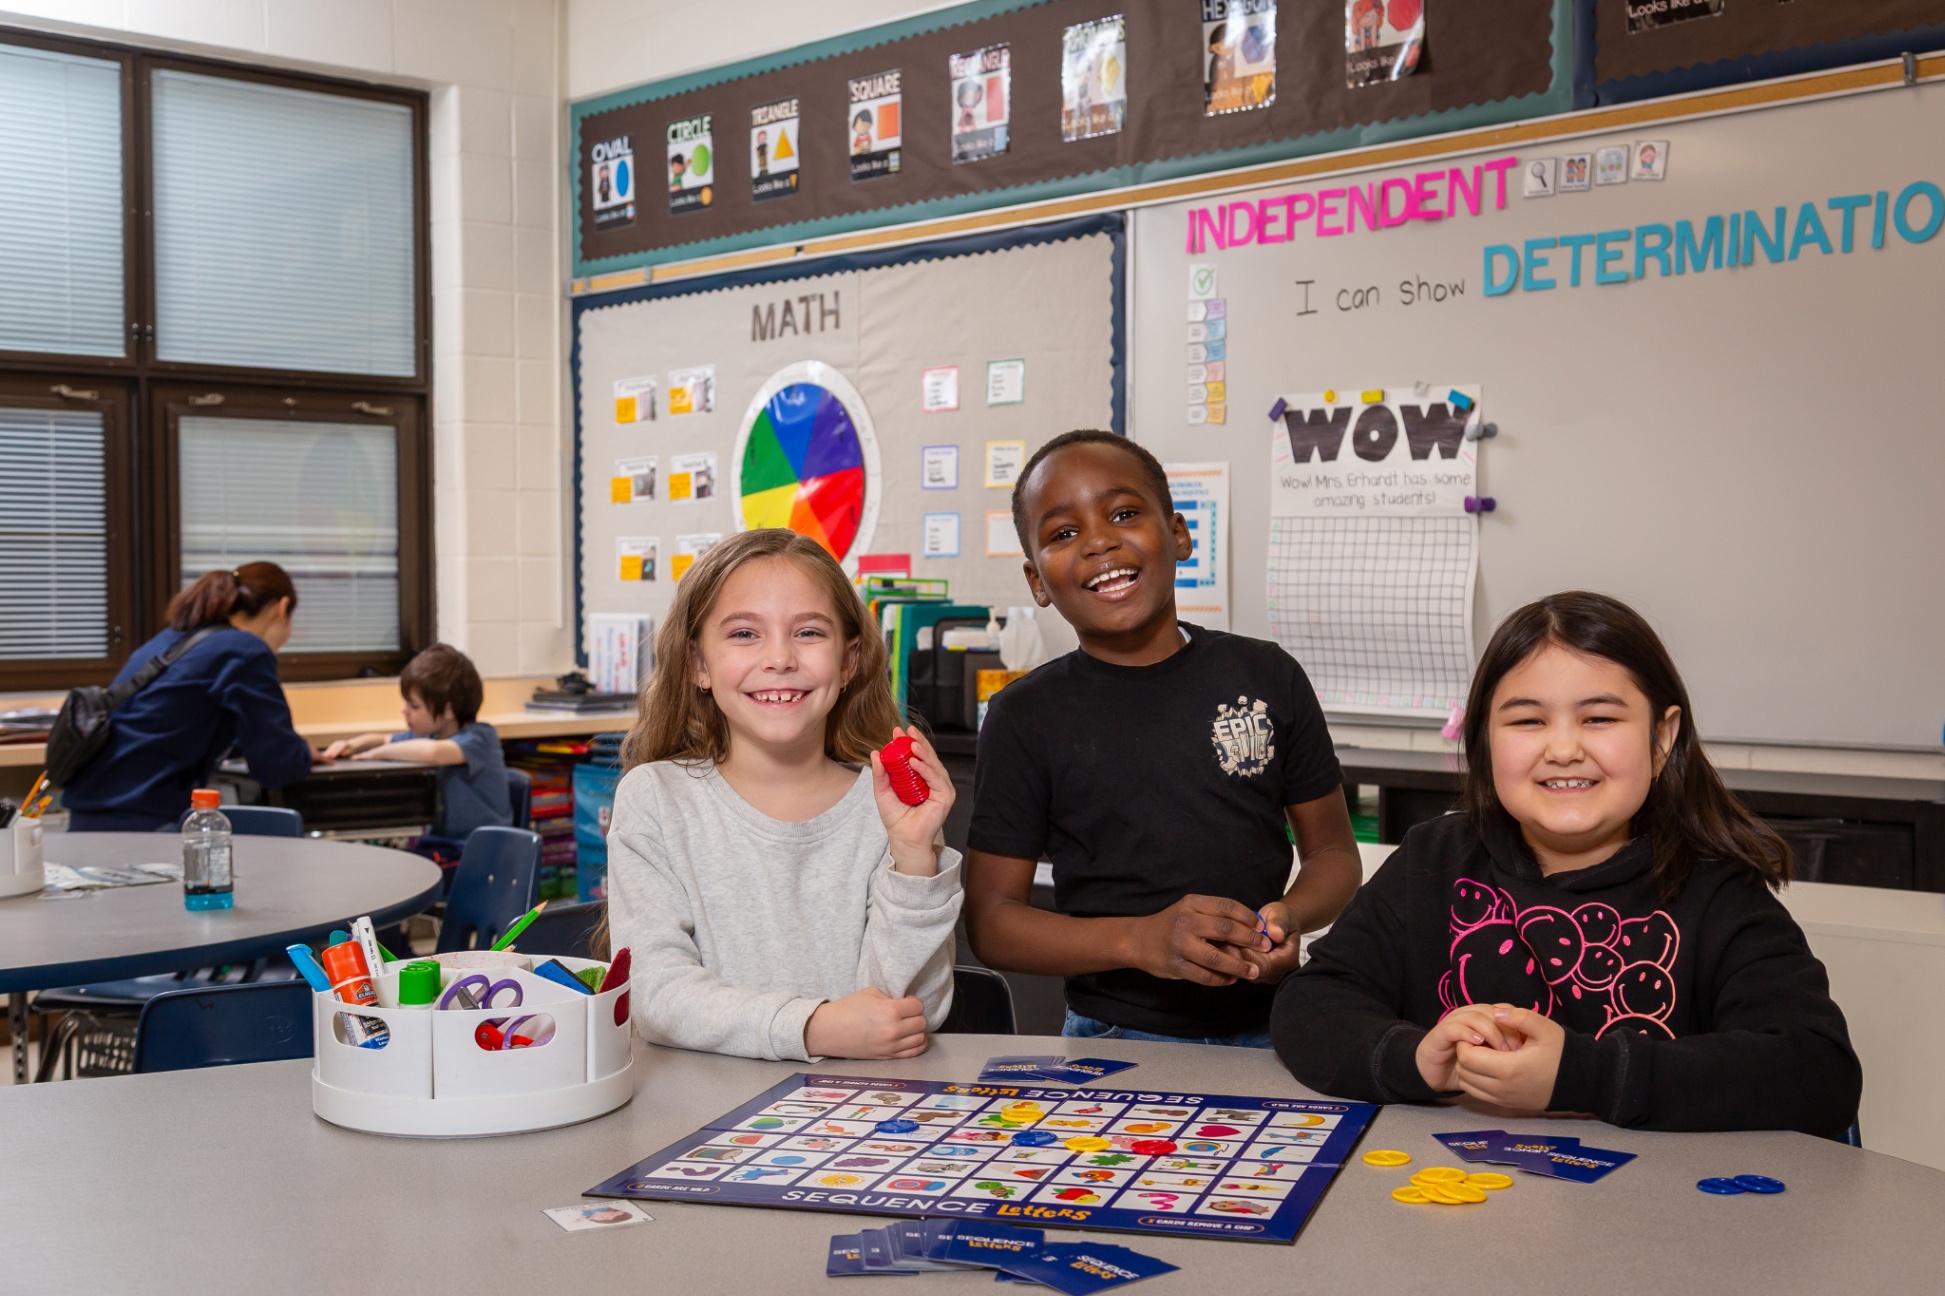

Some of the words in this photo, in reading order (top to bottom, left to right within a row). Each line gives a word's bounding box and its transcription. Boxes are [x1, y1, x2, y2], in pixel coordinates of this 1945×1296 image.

[1628, 1, 1668, 18] Looks
[1350, 56, 1378, 73] Looks
[851, 72, 901, 102] SQUARE
[751, 99, 799, 126] TRIANGLE
[667, 115, 712, 143] CIRCLE
[591, 136, 632, 162] OVAL
[1185, 156, 1518, 255] INDEPENDENT
[1483, 181, 1945, 297] DETERMINATIO
[1296, 280, 1318, 316] I
[1336, 284, 1380, 312] can
[1400, 274, 1465, 306] show
[752, 290, 840, 342] MATH
[1284, 402, 1475, 464] WOW
[1347, 472, 1398, 487] Erhardt
[1403, 472, 1427, 486] has
[1434, 473, 1472, 486] some
[1314, 495, 1366, 510] amazing
[1373, 491, 1436, 507] students!
[1213, 714, 1268, 742] EPIC
[942, 1085, 1020, 1097] Letters
[1024, 1089, 1204, 1104] SEQUENCE
[1547, 1151, 1616, 1167] SEQUENCE
[1551, 1156, 1599, 1169] Letters
[781, 1190, 989, 1214] SEQUENCE
[996, 1203, 1092, 1221] Letters
[1187, 1220, 1225, 1229] REMOVE
[956, 1234, 1036, 1248] SEQUENCE
[969, 1240, 1022, 1252] Letters
[1070, 1260, 1117, 1280] Letters
[1076, 1254, 1140, 1280] SEQUENCE
